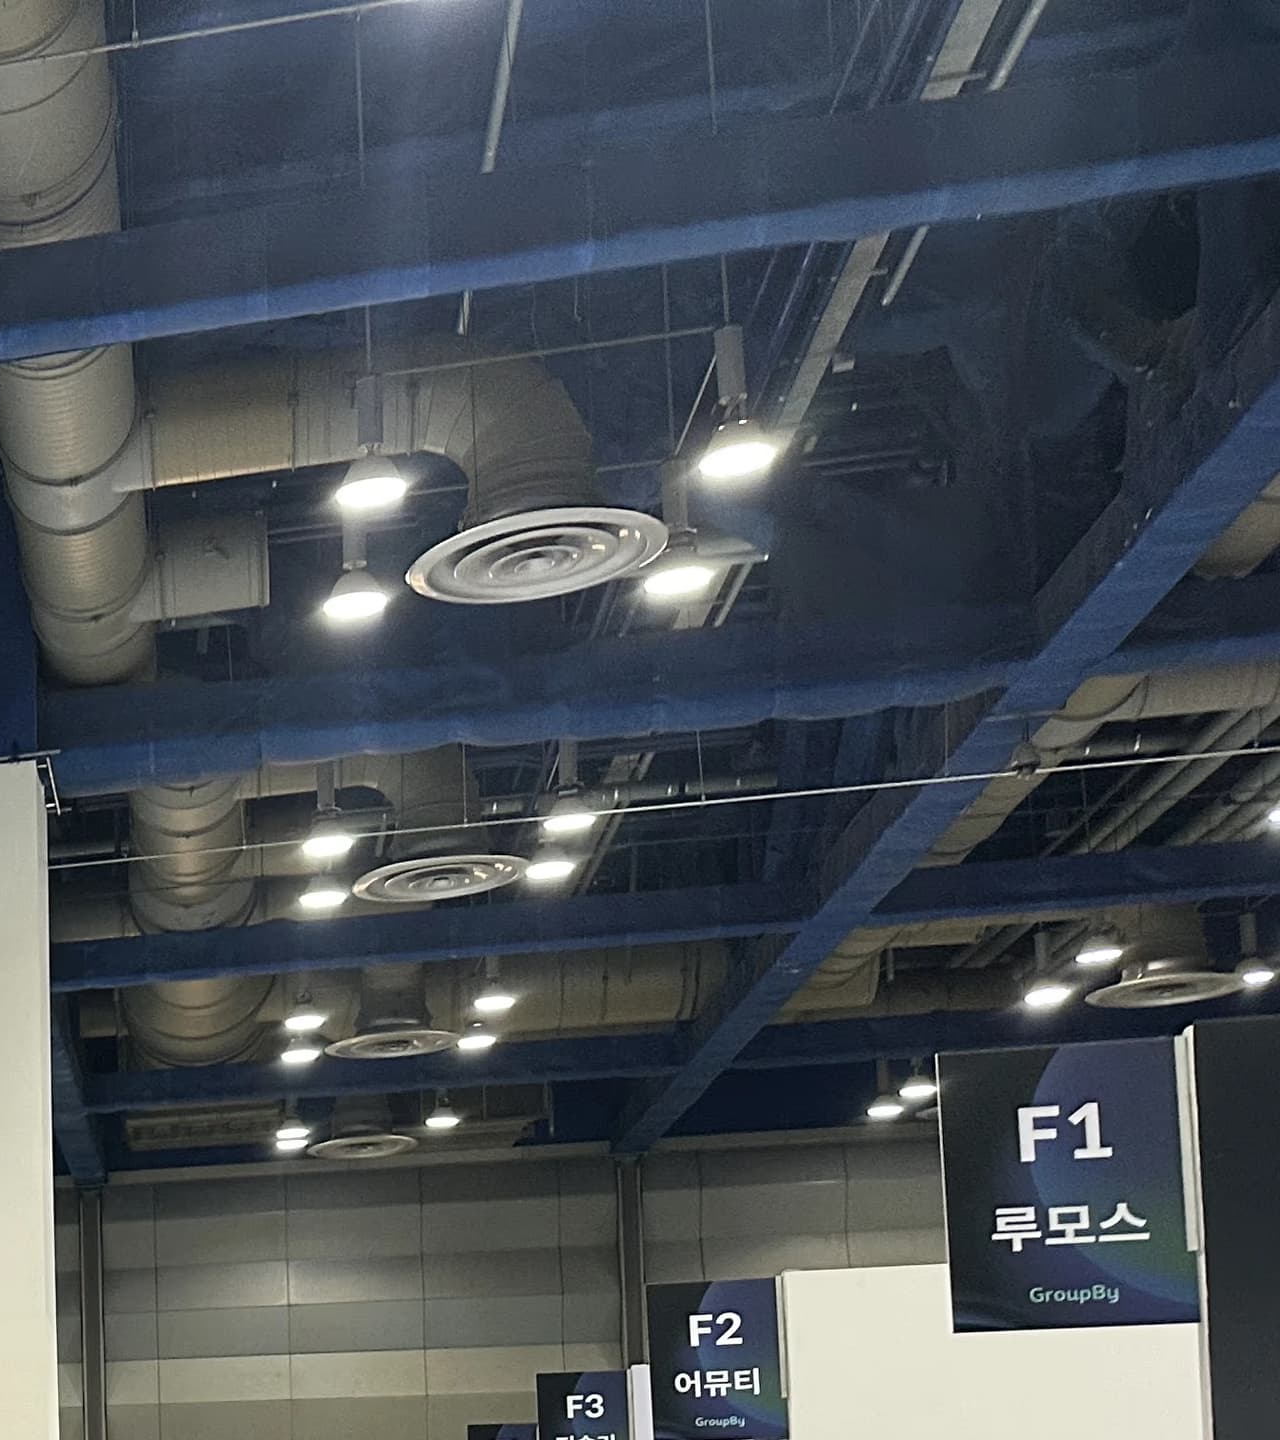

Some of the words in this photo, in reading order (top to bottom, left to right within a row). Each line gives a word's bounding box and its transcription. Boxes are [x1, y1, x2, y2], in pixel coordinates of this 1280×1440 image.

[1017, 1101, 1113, 1163] F1
[991, 1202, 1151, 1253] 루모스
[1029, 1284, 1120, 1304] GroupBy
[689, 1311, 744, 1347] F2
[674, 1367, 761, 1398] 어뮤티
[566, 1393, 605, 1419] F3
[695, 1415, 746, 1428] GroupBy
